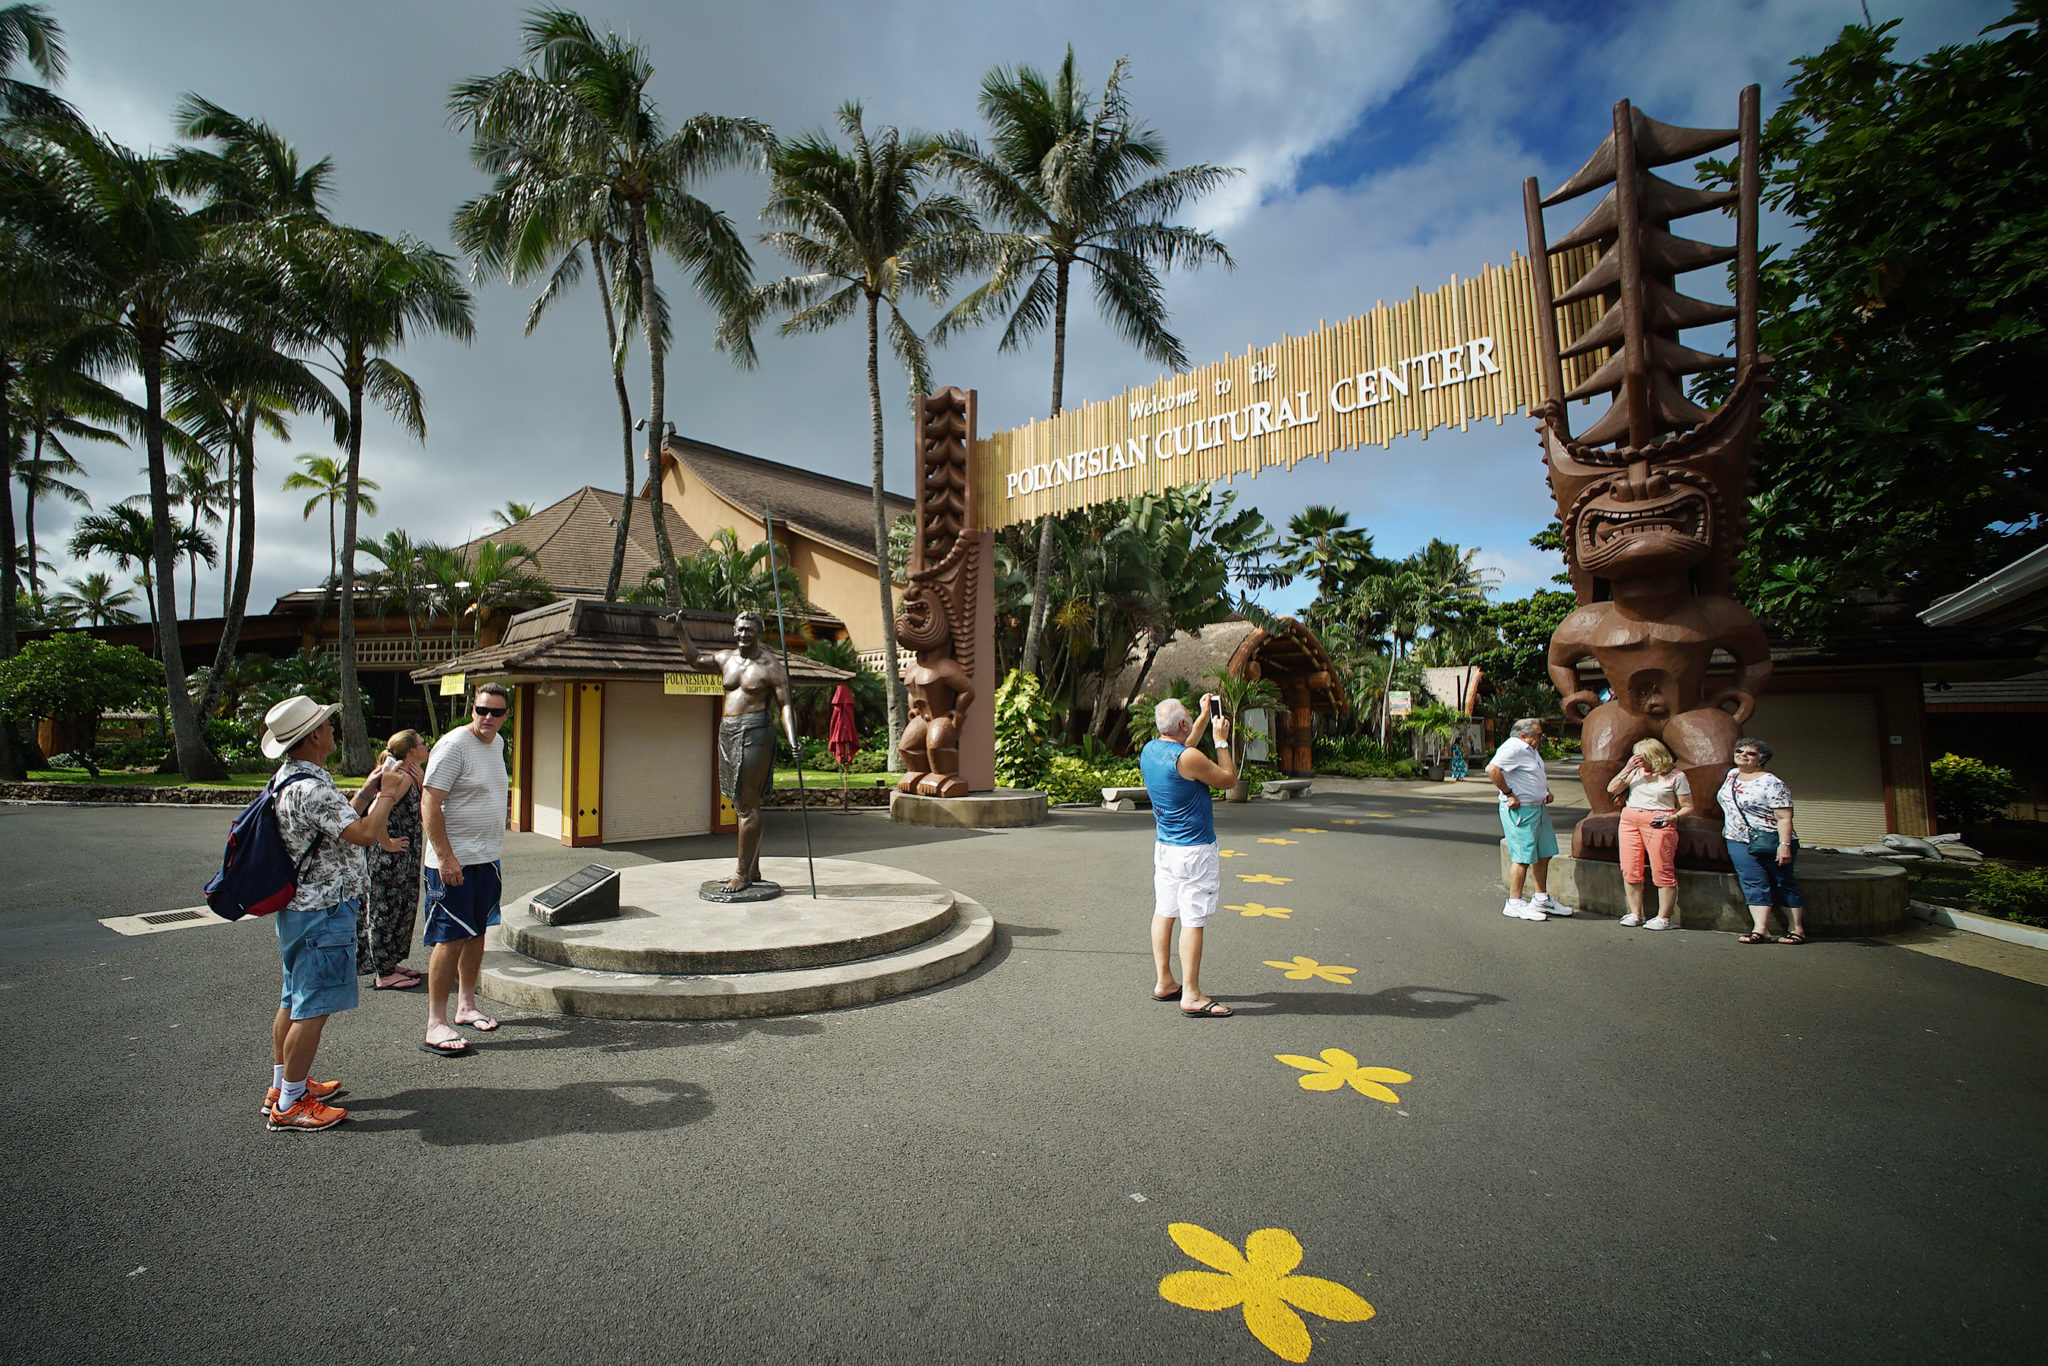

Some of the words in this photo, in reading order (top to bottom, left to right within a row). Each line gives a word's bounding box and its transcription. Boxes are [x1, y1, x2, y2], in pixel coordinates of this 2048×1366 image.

[1006, 434, 1149, 499] POLYNESIAN
[1154, 390, 1319, 460] CULTURAL
[1330, 336, 1500, 414] CENTER
[1129, 388, 1199, 421] Welcome
[1214, 376, 1232, 397] to
[1250, 360, 1278, 385] the
[665, 672, 709, 685] POLYNESIAN
